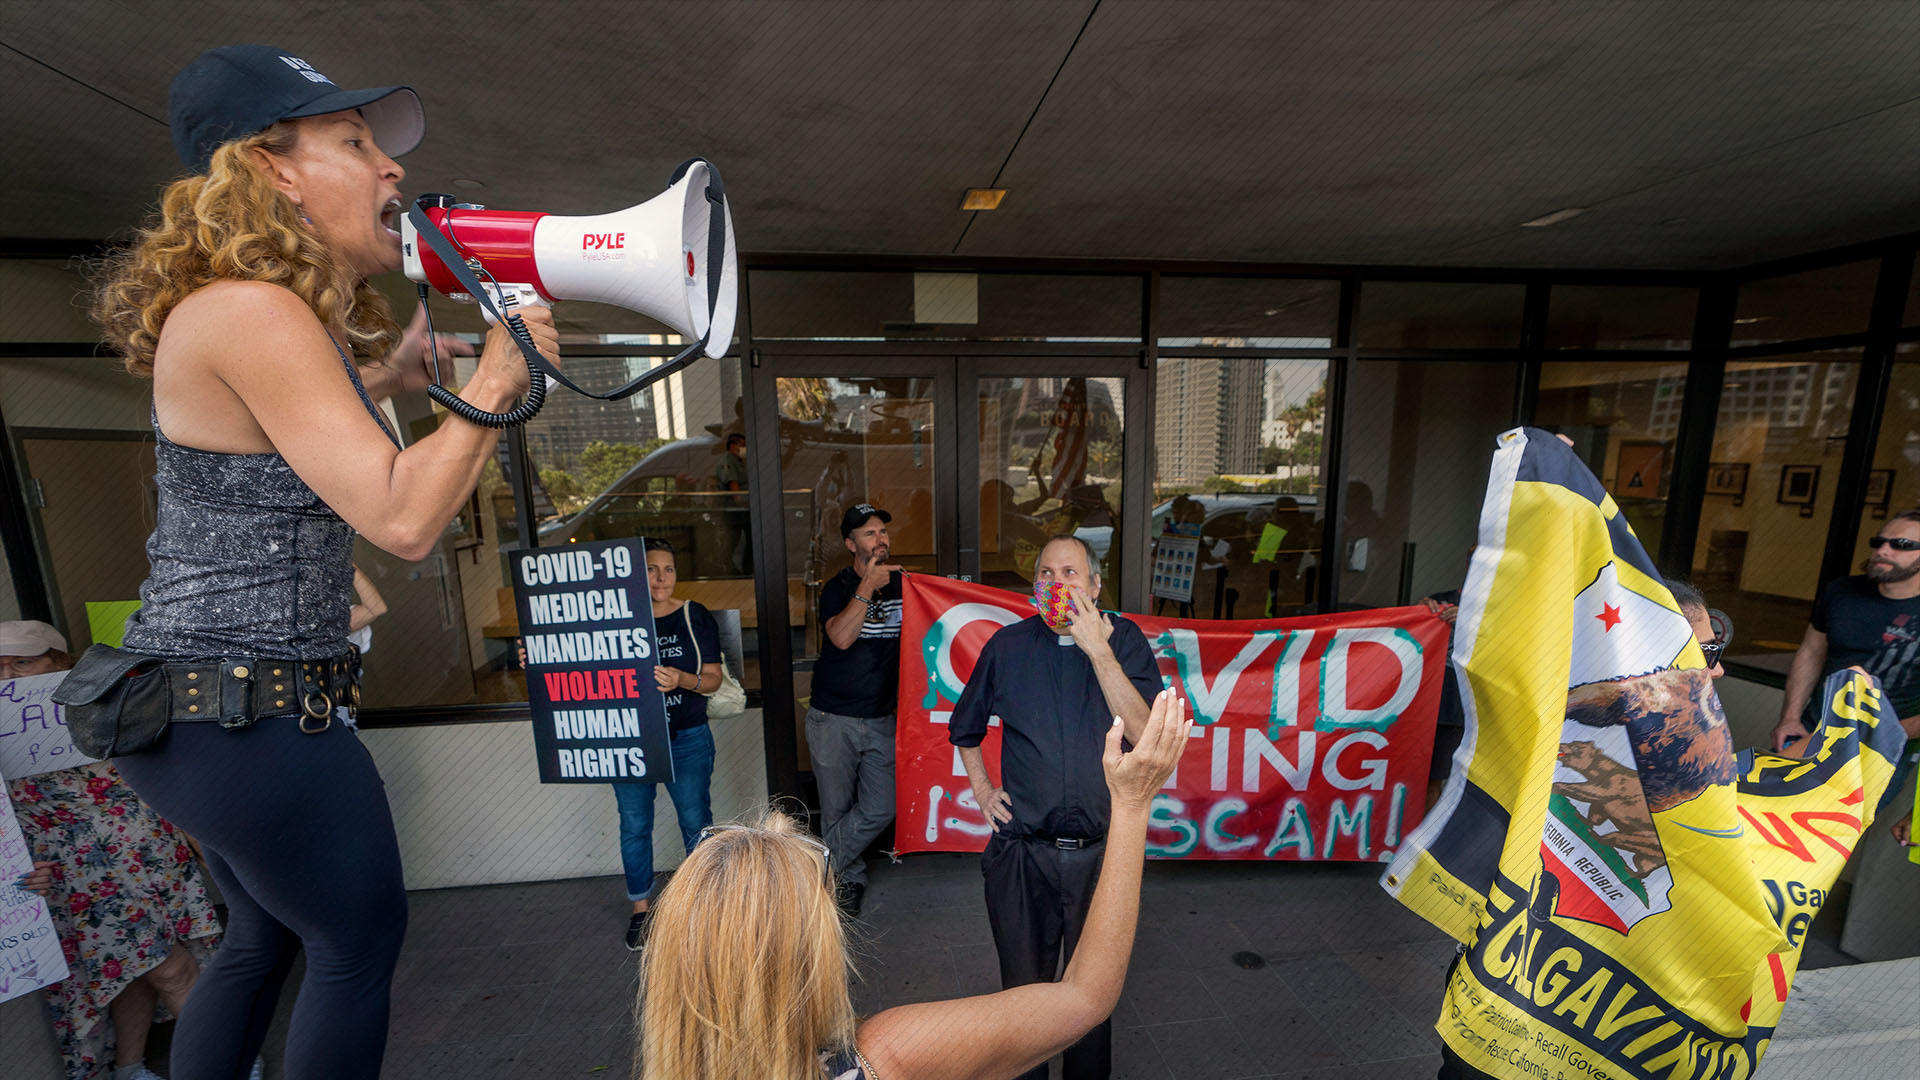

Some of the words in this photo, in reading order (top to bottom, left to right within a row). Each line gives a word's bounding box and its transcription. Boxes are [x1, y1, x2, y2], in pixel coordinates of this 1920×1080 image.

[583, 233, 624, 250] PYLE
[521, 546, 632, 586] COVID-19
[528, 588, 633, 625] MEDICAL
[525, 628, 650, 664] MANDATES
[544, 668, 640, 701] VIOLATE
[922, 602, 1423, 735] CVID
[553, 708, 640, 739] HUMAN
[558, 747, 646, 778] RIGHTS
[1430, 872, 1467, 907] Paid
[1574, 857, 1624, 901] REPUBLIC
[1535, 1032, 1569, 1061] Recall
